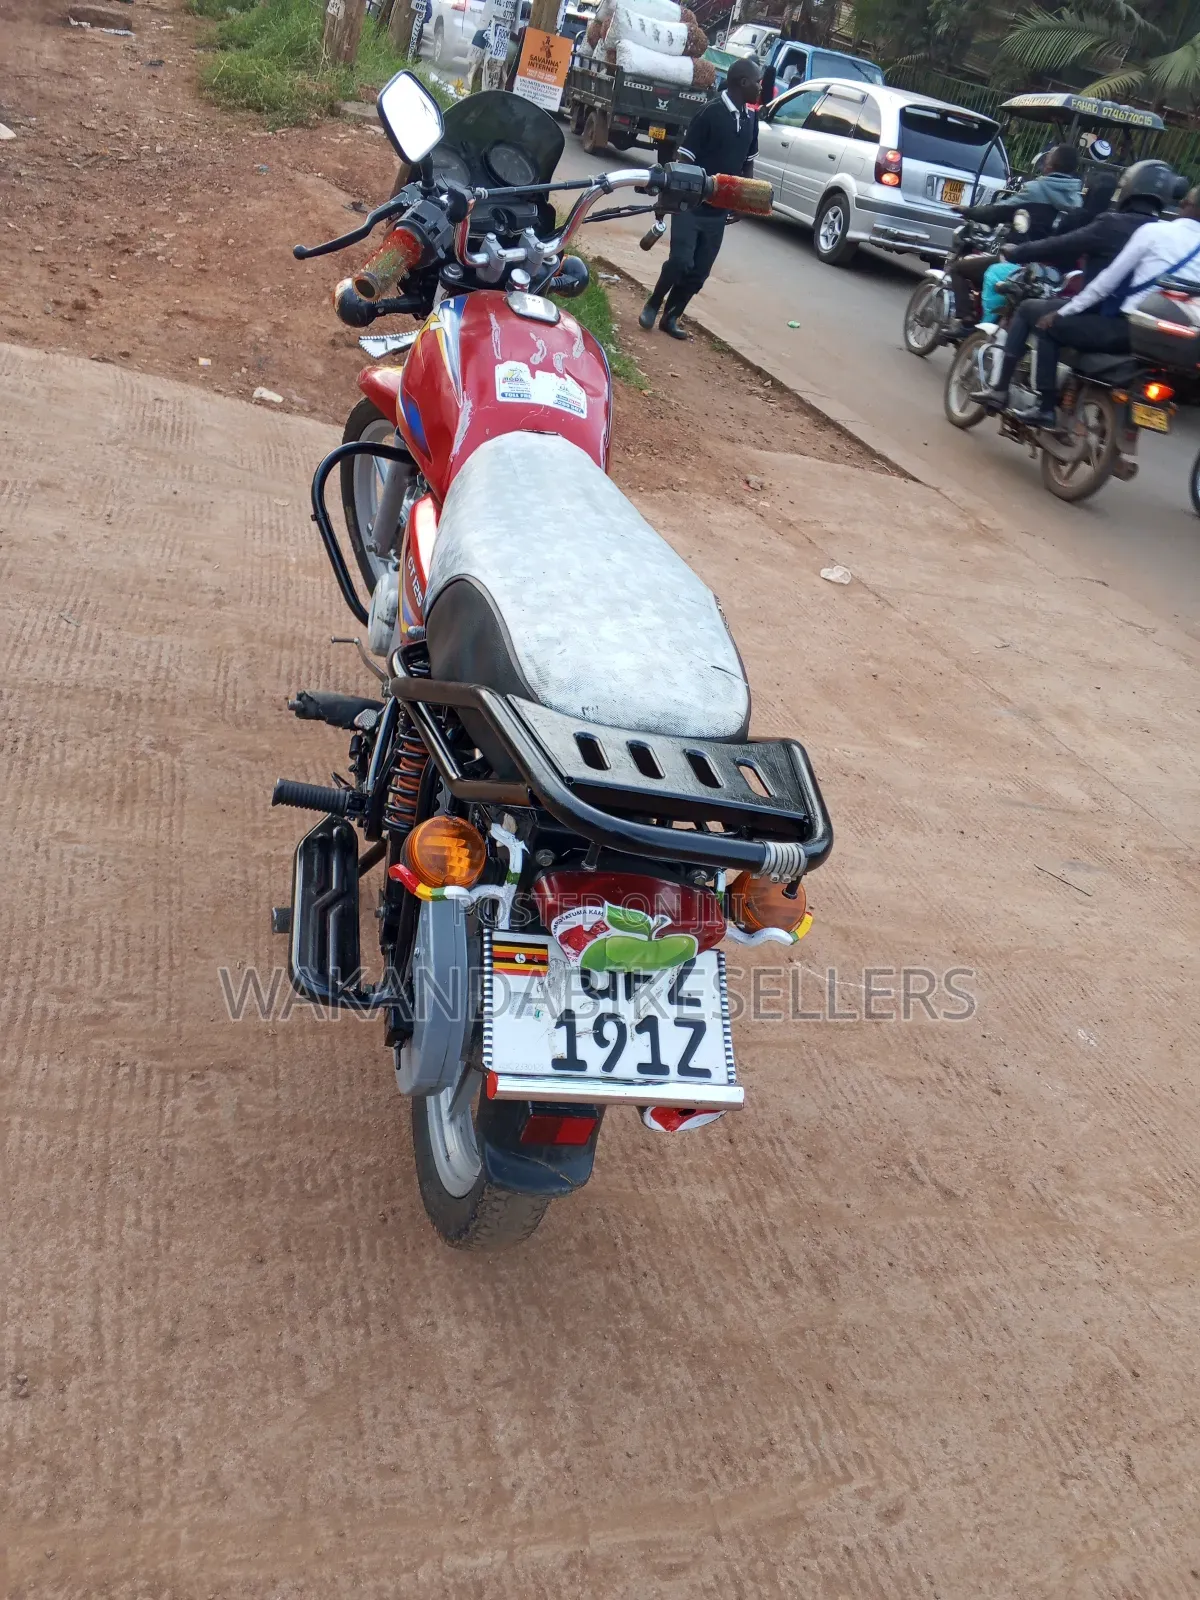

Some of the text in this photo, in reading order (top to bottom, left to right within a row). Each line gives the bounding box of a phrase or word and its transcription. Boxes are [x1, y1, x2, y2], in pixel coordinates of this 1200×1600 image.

[527, 61, 559, 74] INTERNET
[529, 54, 559, 69] SAVANNA
[1071, 98, 1098, 115] FAHAD
[551, 1009, 712, 1079] 191Z
